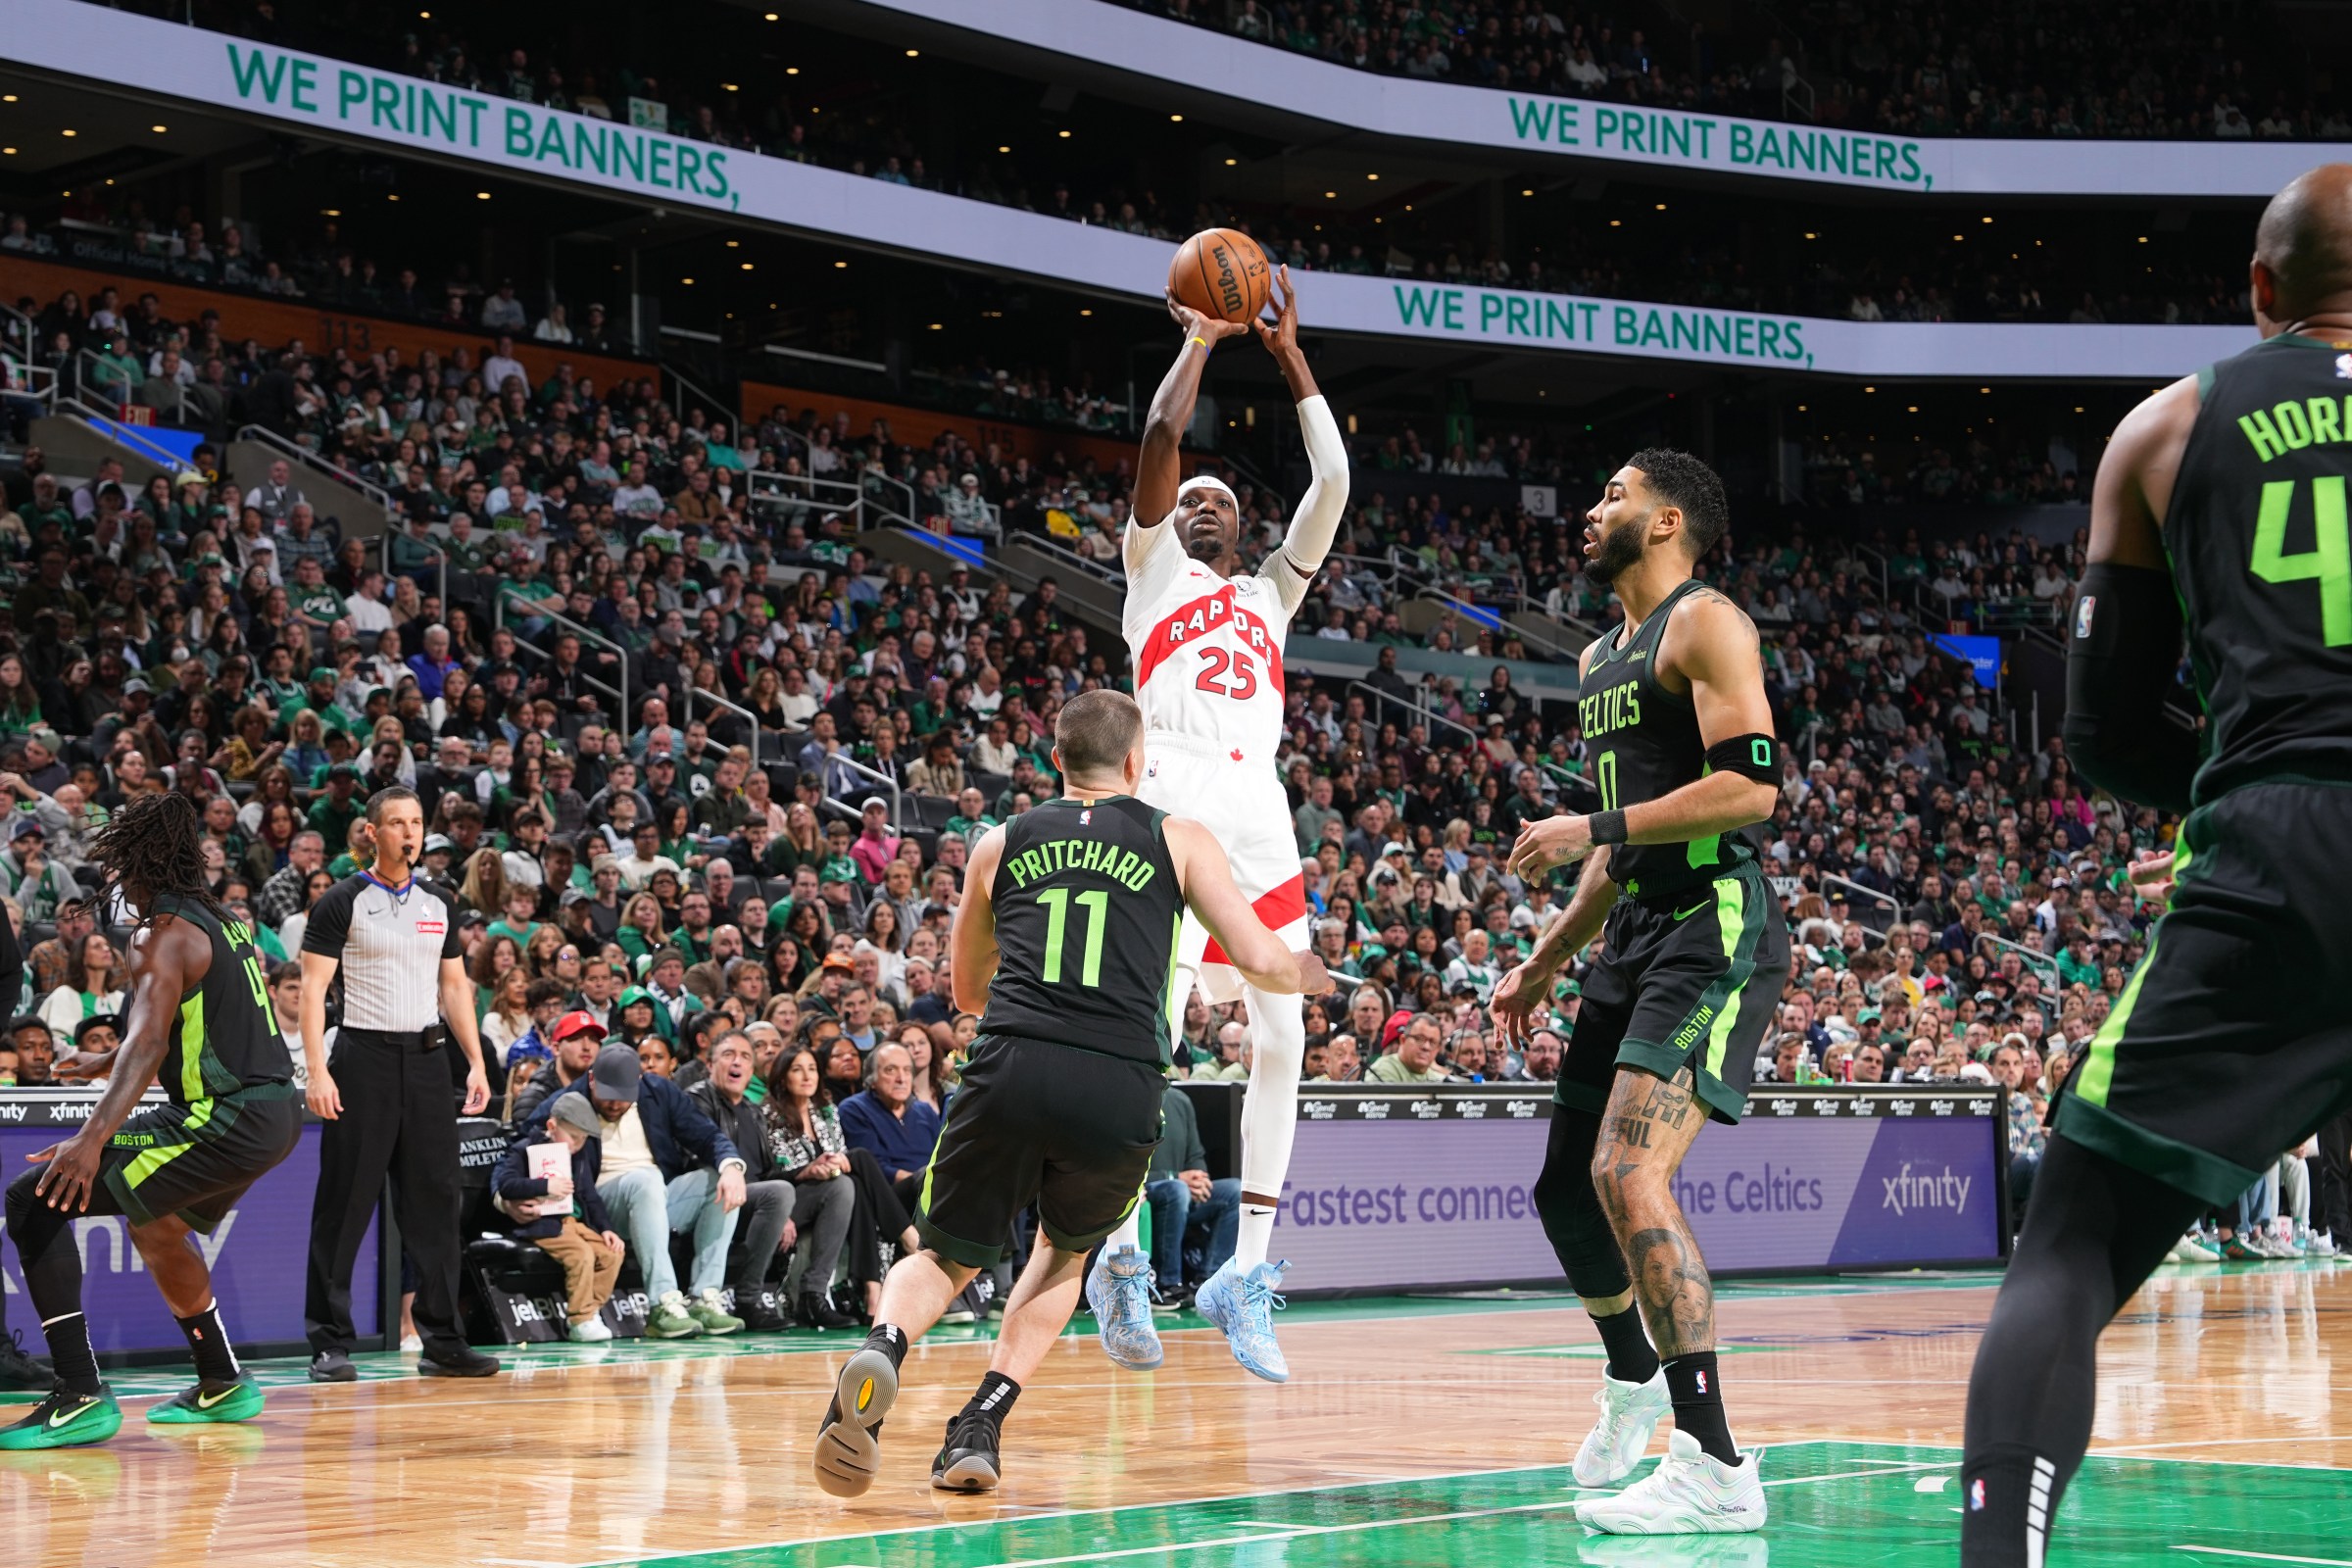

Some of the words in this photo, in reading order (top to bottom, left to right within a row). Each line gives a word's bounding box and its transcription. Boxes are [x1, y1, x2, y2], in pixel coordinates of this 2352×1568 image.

[226, 43, 318, 113] WE
[339, 69, 488, 147] PRINT
[505, 107, 740, 213] BANNERS,
[1508, 98, 1579, 145] WE
[1595, 108, 1717, 160] PRINT
[1730, 123, 1933, 191] BANNERS,
[1212, 245, 1243, 315] Wilson
[320, 317, 371, 351] 113
[1393, 285, 1464, 330] WE
[1480, 293, 1600, 342] PRINT
[1613, 306, 1814, 370] BANNERS,
[125, 405, 151, 426] EXIT
[1533, 490, 1545, 513] 3
[2250, 476, 2352, 648] 4
[1169, 599, 1273, 668] RAPORS
[1196, 647, 1257, 701] 25
[1579, 679, 1641, 742] CELTICS
[1598, 750, 1618, 811] 0
[1751, 738, 1772, 767] 0
[1007, 839, 1155, 892] PRITCHARD
[1036, 887, 1108, 988] 11
[1674, 1004, 1714, 1050] BOSTON
[114, 1134, 154, 1147] BOSTON
[1275, 1181, 1406, 1226] Fastest
[1725, 1162, 1823, 1213] Celtics
[1883, 1163, 1972, 1216] xfinity
